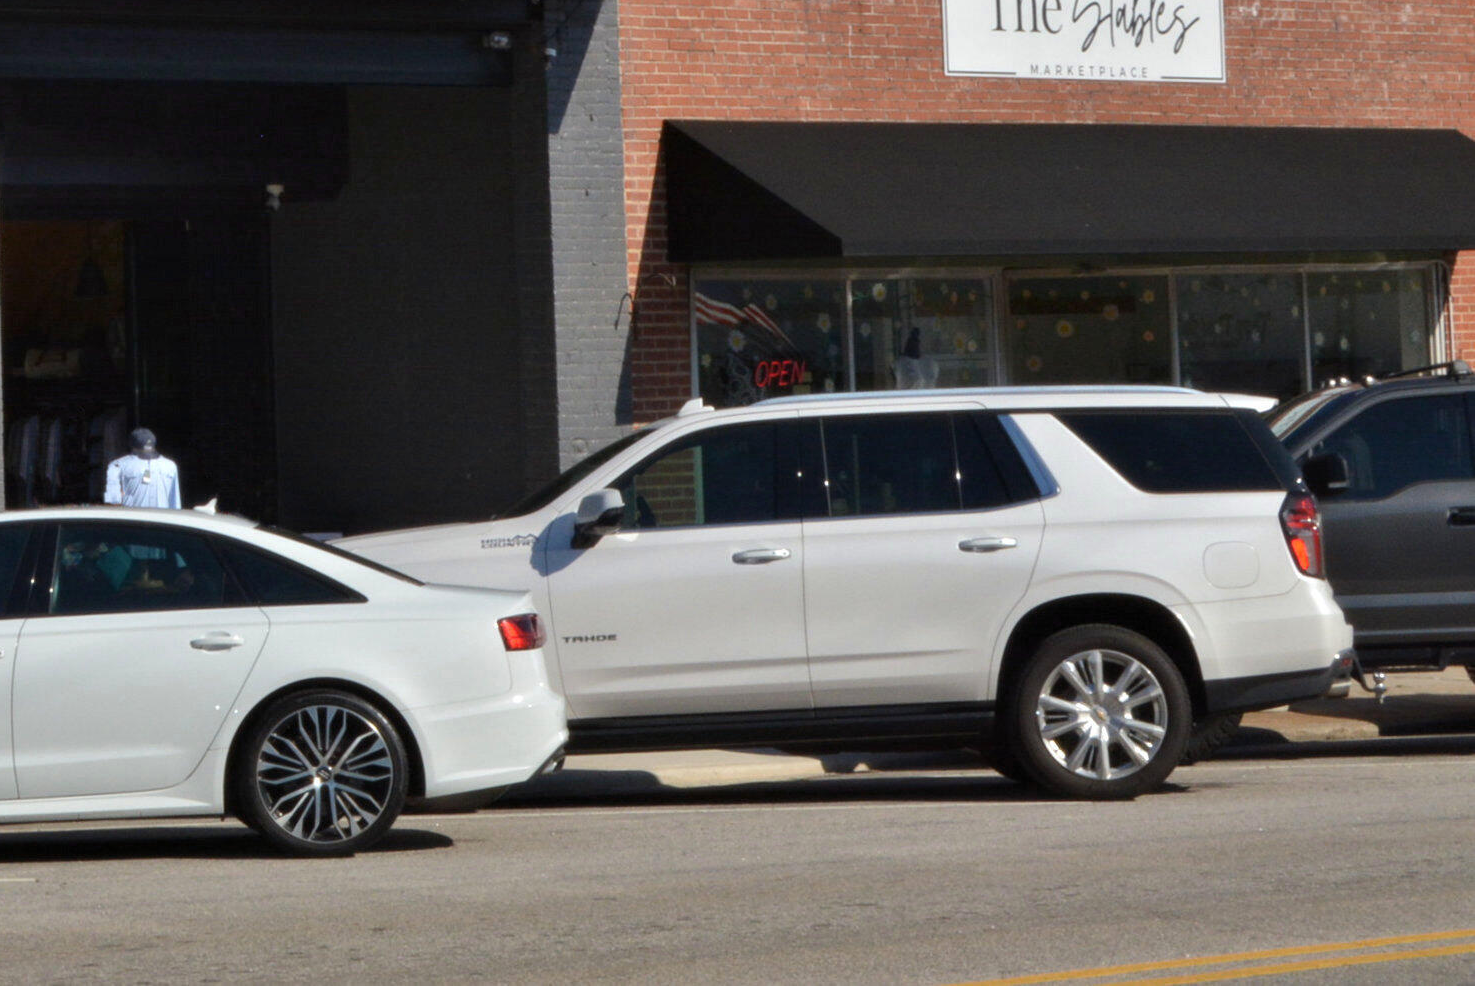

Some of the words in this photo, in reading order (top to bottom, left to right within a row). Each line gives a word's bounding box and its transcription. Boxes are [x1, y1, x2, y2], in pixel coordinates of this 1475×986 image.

[1030, 64, 1148, 79] MARKETPLACE
[754, 360, 807, 387] OPEN
[562, 634, 617, 644] TAHOE
